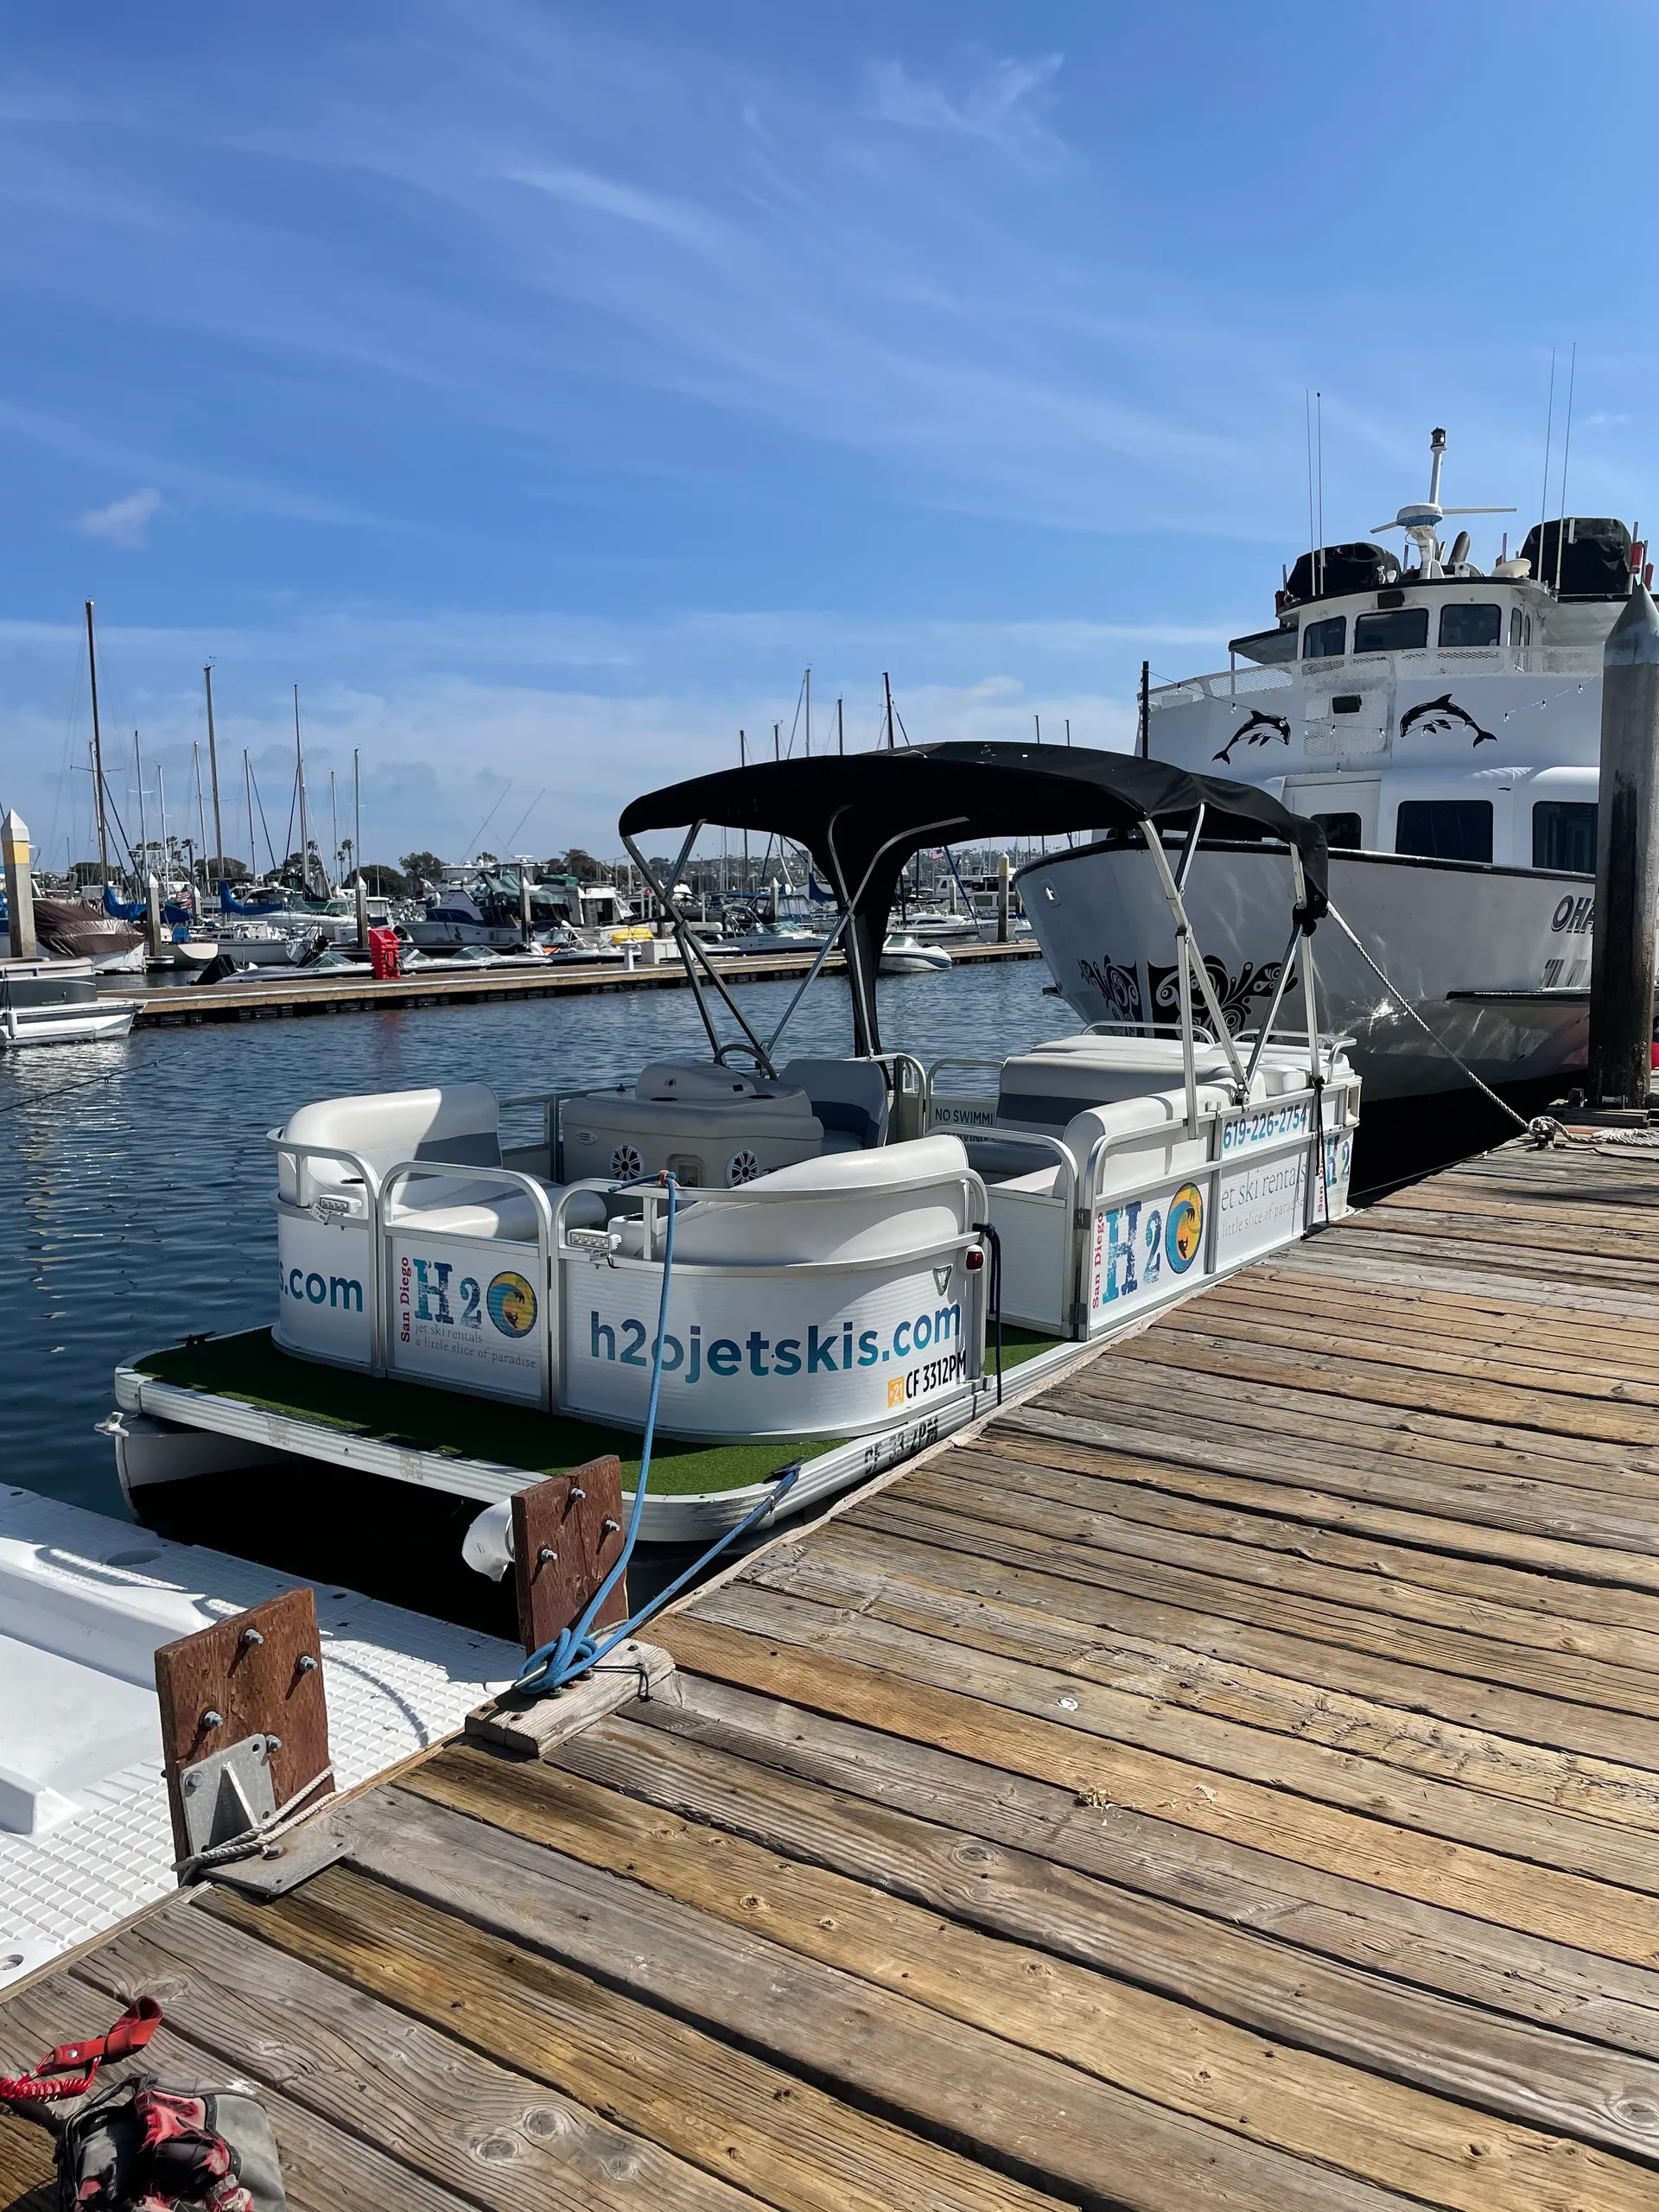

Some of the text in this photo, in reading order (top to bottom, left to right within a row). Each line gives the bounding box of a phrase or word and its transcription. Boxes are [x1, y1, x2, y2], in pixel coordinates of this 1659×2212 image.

[935, 1108, 995, 1126] NO SWIMMI
[1224, 1102, 1307, 1149] 619-226-2754
[1220, 1164, 1306, 1211] et ski rentals
[1222, 1198, 1305, 1240] little slice of paradise
[1092, 1211, 1105, 1309] San Diego
[399, 1256, 412, 1343] San Diego
[415, 1323, 484, 1344] jet ski rentals
[415, 1337, 537, 1369] a little slice of paradise
[591, 1303, 961, 1384] h2ojetskis.com
[906, 1350, 966, 1399] CF 3312PM
